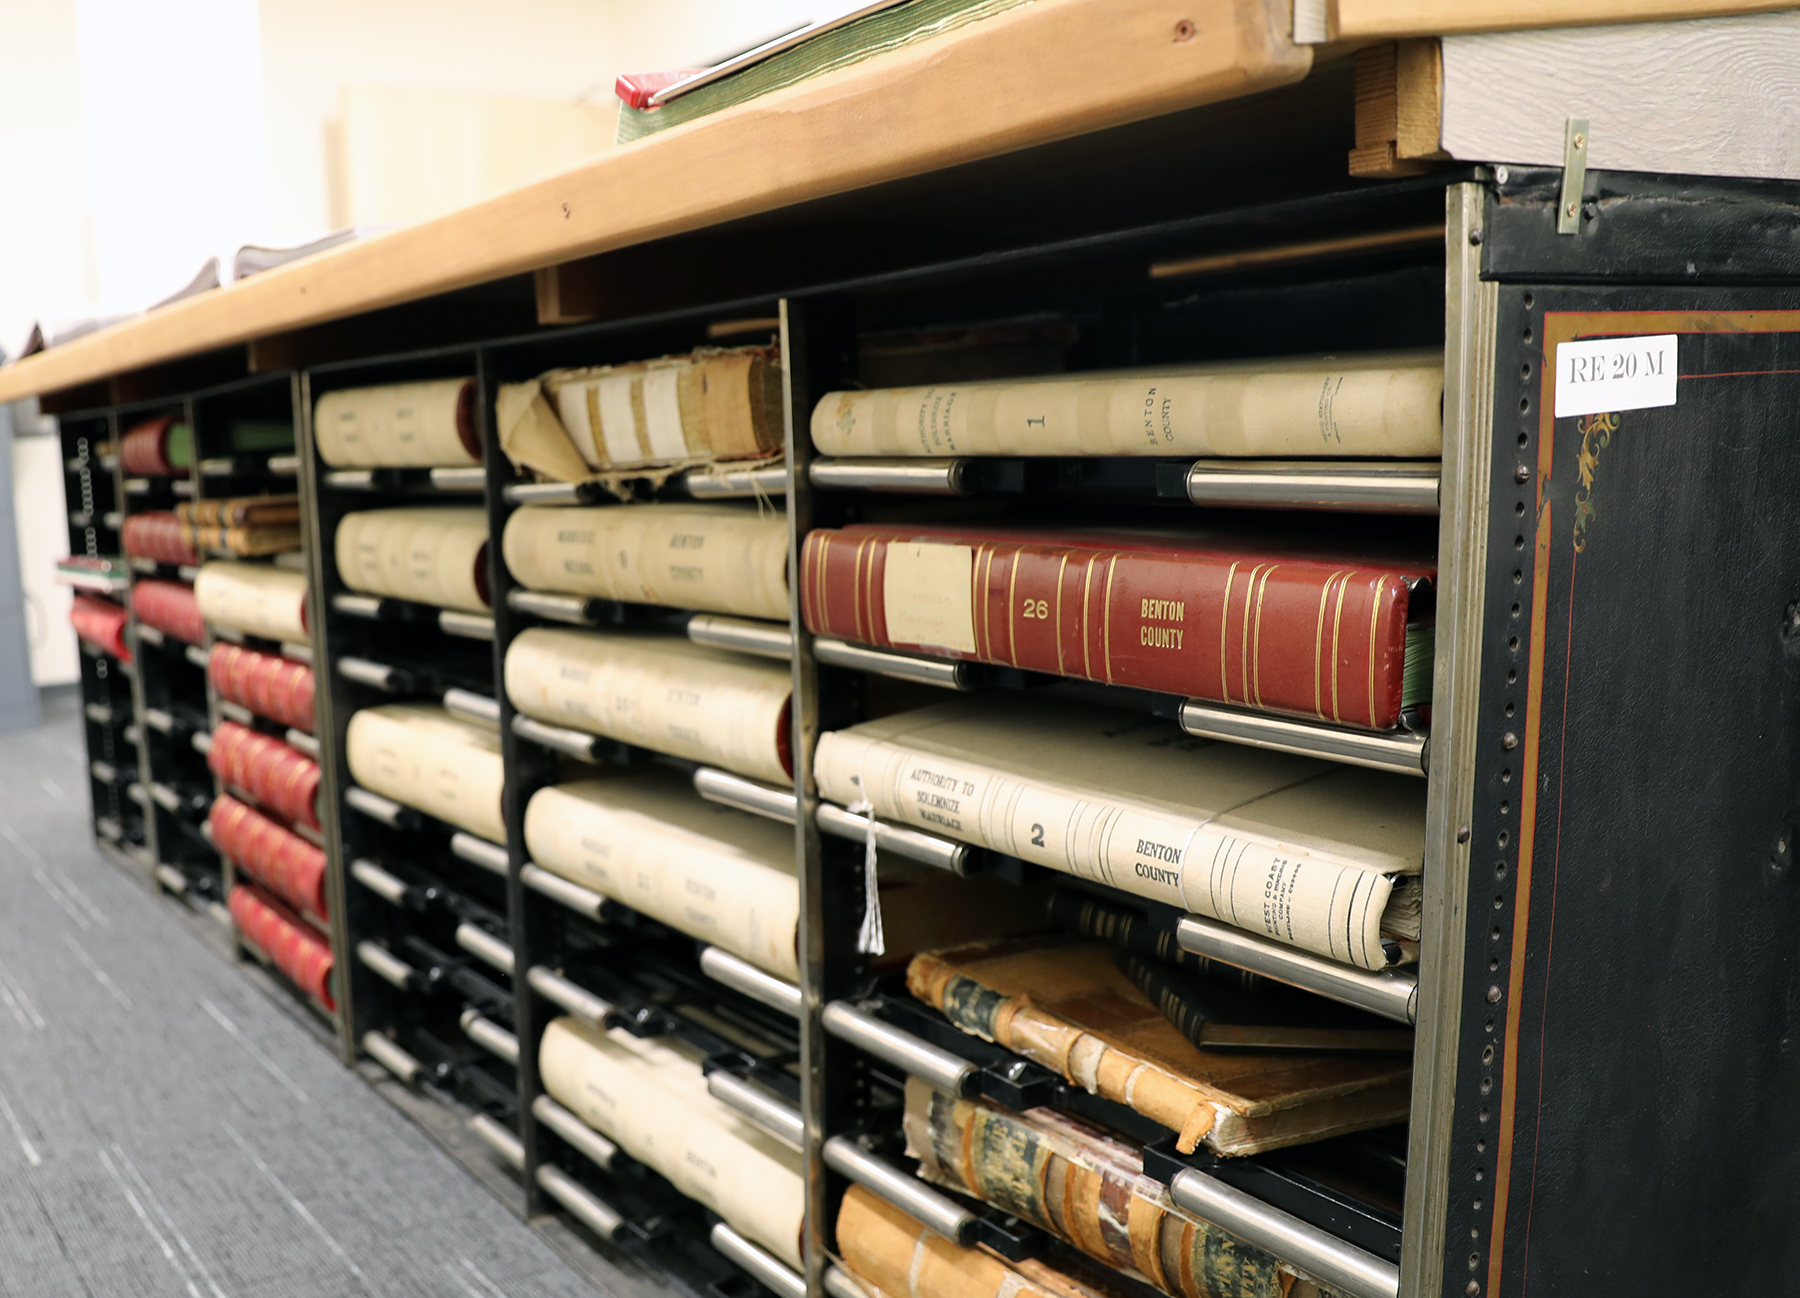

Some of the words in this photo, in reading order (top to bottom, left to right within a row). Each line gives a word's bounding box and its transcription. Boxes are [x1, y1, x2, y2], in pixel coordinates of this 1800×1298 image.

[1569, 355, 1605, 384] RE
[1612, 352, 1637, 380] 20
[1644, 349, 1665, 376] M
[943, 391, 958, 451] MARRIAGE
[1026, 414, 1046, 429] 1
[1144, 387, 1158, 446] BENTON
[1161, 397, 1174, 442] COUNTY
[1023, 598, 1049, 620] 26
[1141, 597, 1185, 622] BENTON
[1140, 625, 1184, 650] COUNTY
[911, 768, 960, 792] AUTHORITY
[962, 781, 975, 797] TO
[917, 790, 961, 814] SOLEMNIZE
[1031, 822, 1046, 848] 2
[1136, 838, 1182, 864] BENTON
[1135, 862, 1179, 887] COUNTY
[1264, 857, 1281, 898] COAST
[1278, 881, 1287, 920] COMPANY
[1264, 901, 1273, 933] WEST
